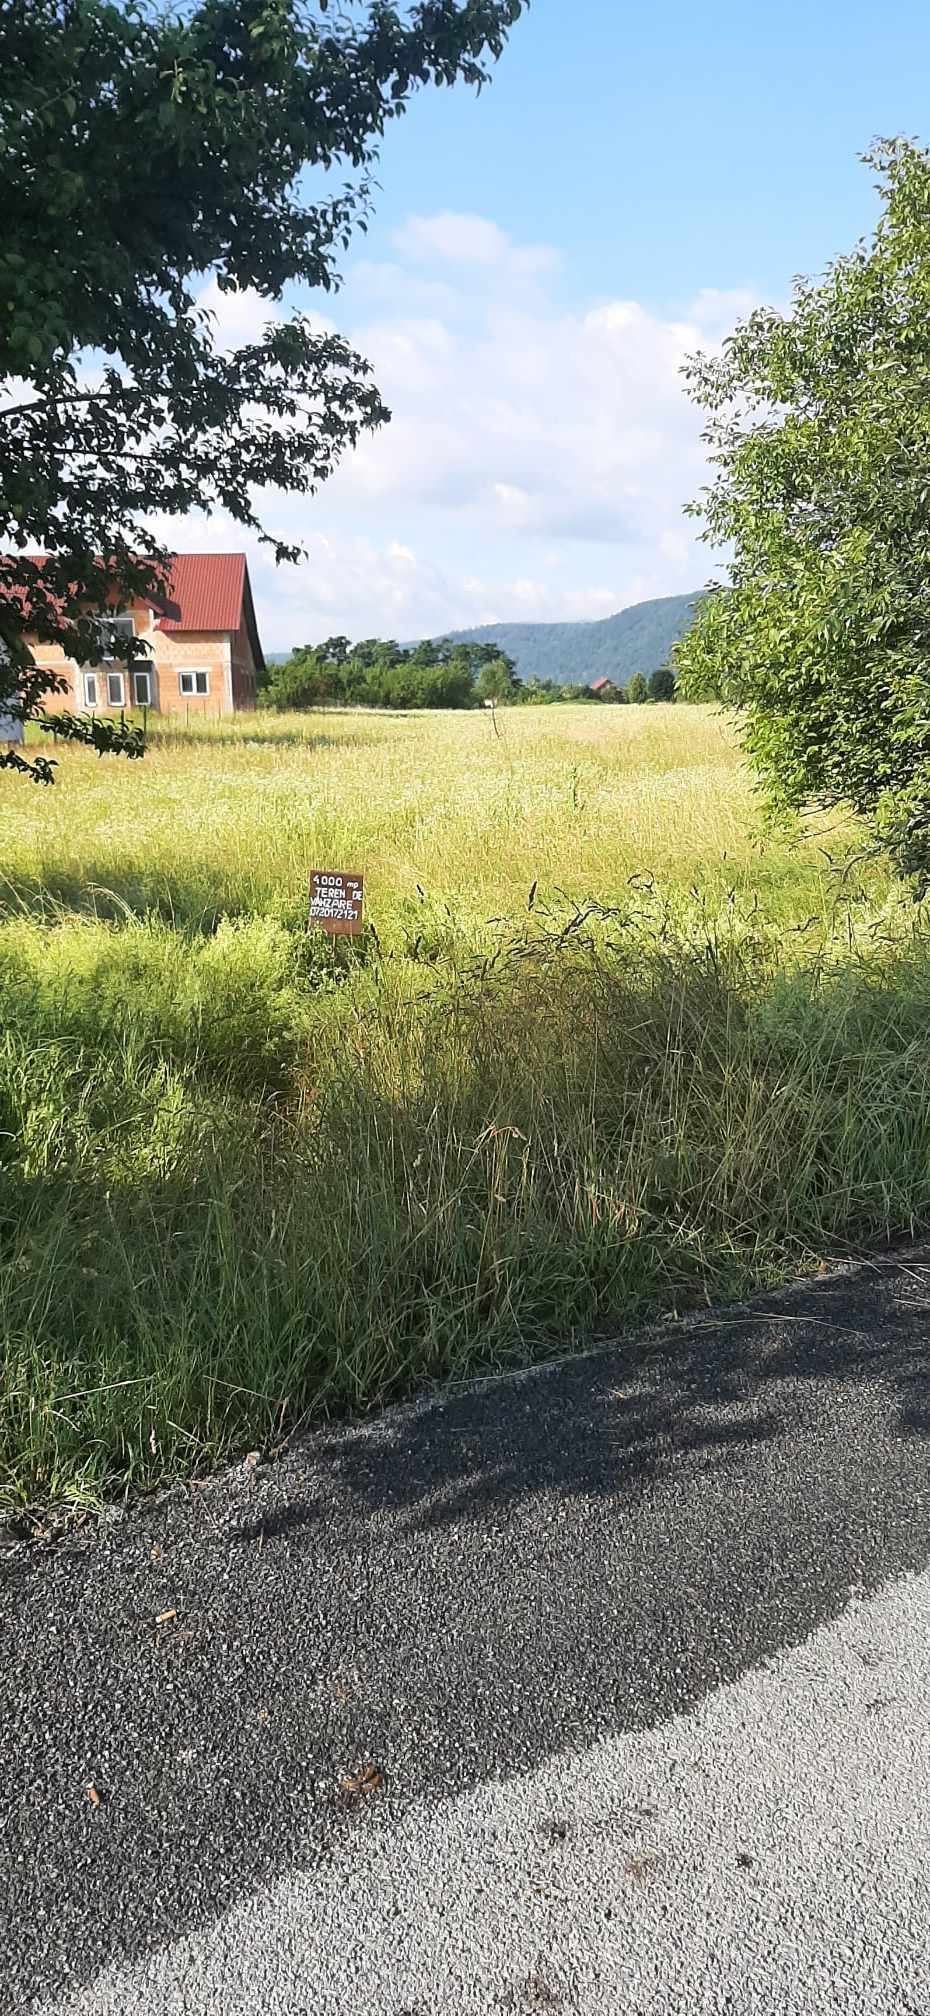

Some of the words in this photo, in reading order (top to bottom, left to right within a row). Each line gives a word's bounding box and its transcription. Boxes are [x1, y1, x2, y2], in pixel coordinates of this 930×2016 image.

[313, 875, 342, 886] 4000
[315, 887, 346, 898] TEREN
[352, 890, 362, 900] DE
[310, 906, 358, 919] 0720172121
